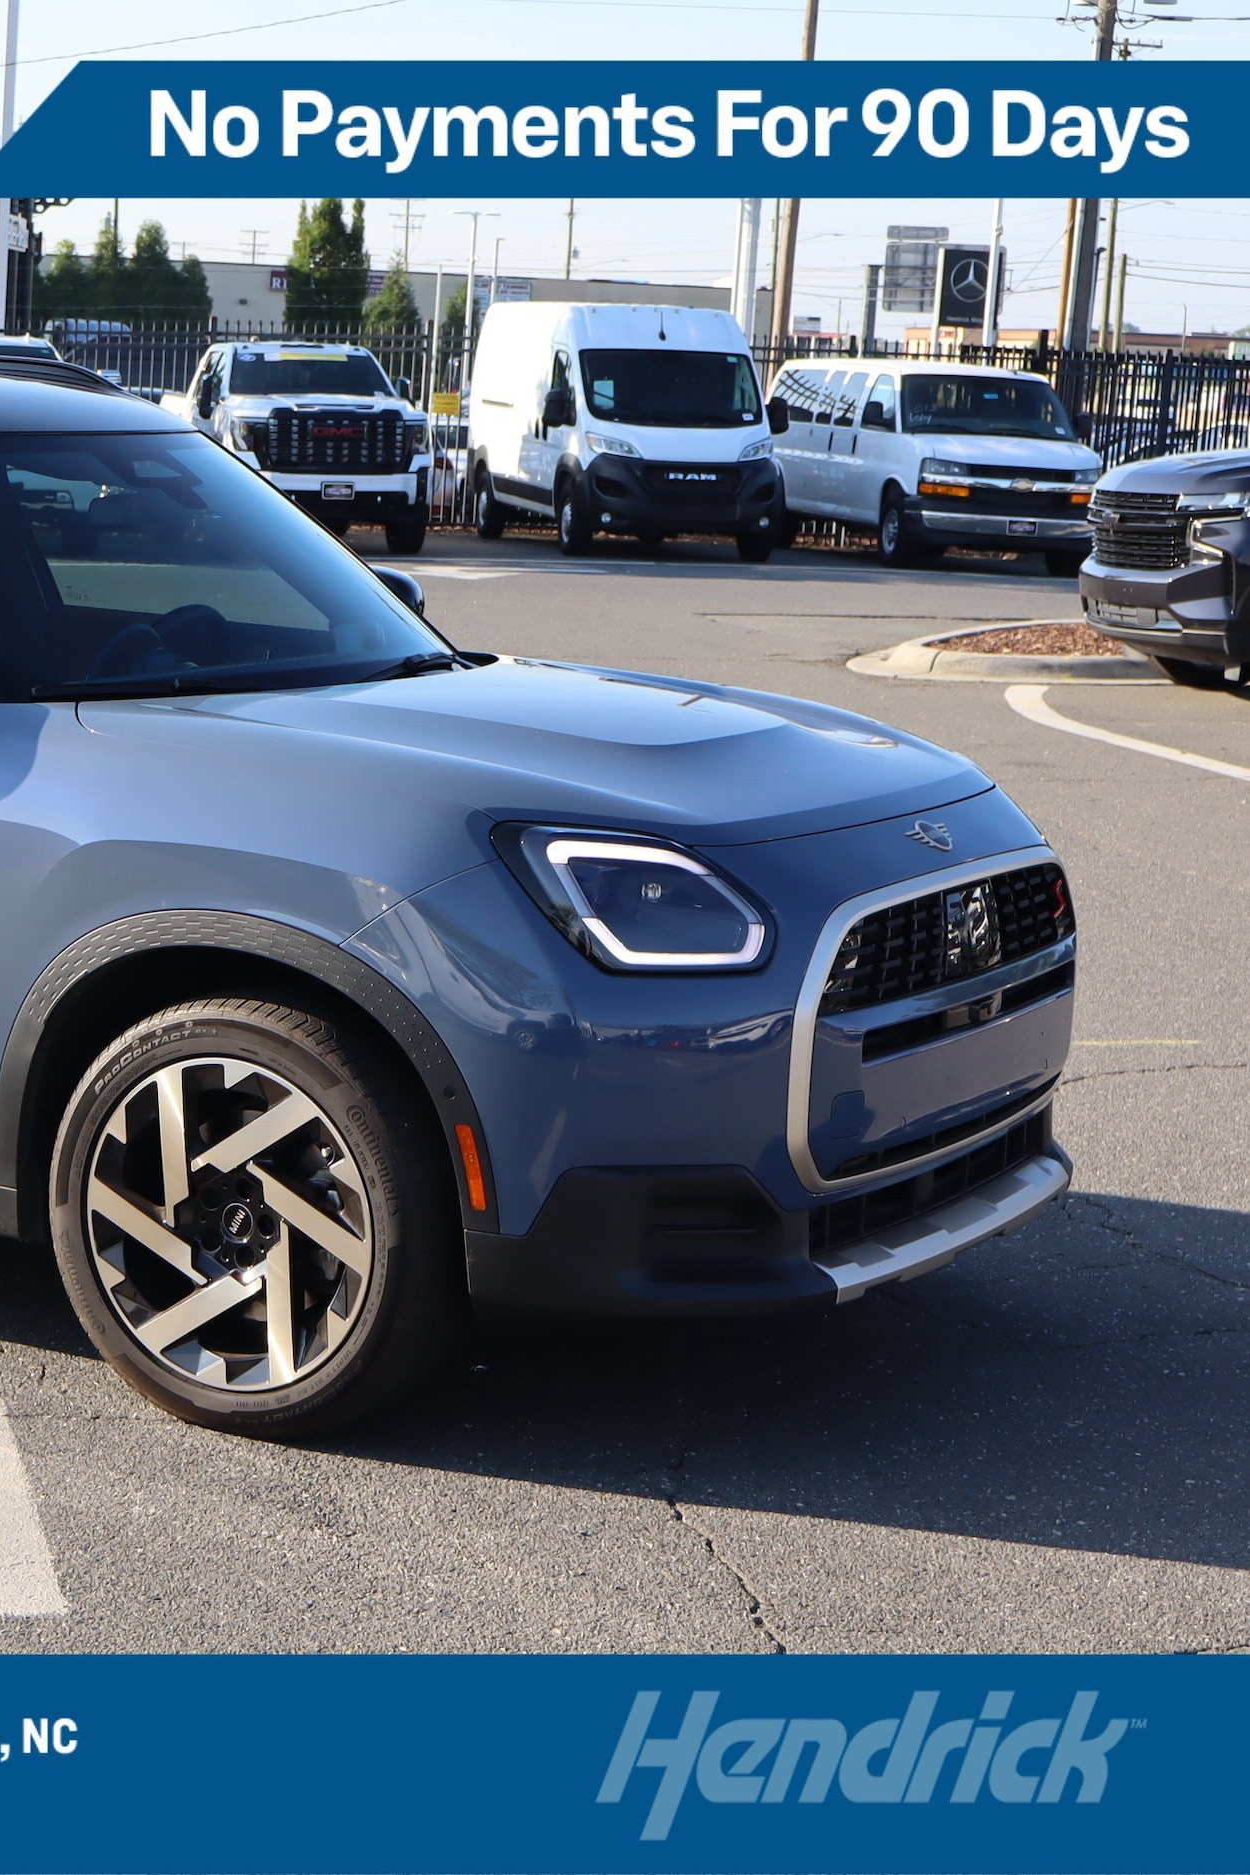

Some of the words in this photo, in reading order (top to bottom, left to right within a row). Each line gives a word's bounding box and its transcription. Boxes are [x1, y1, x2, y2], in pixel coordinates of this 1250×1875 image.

[313, 426, 363, 436] GMC
[668, 472, 716, 481] RAM
[346, 1104, 396, 1203] Continental
[228, 1209, 246, 1234] MINI
